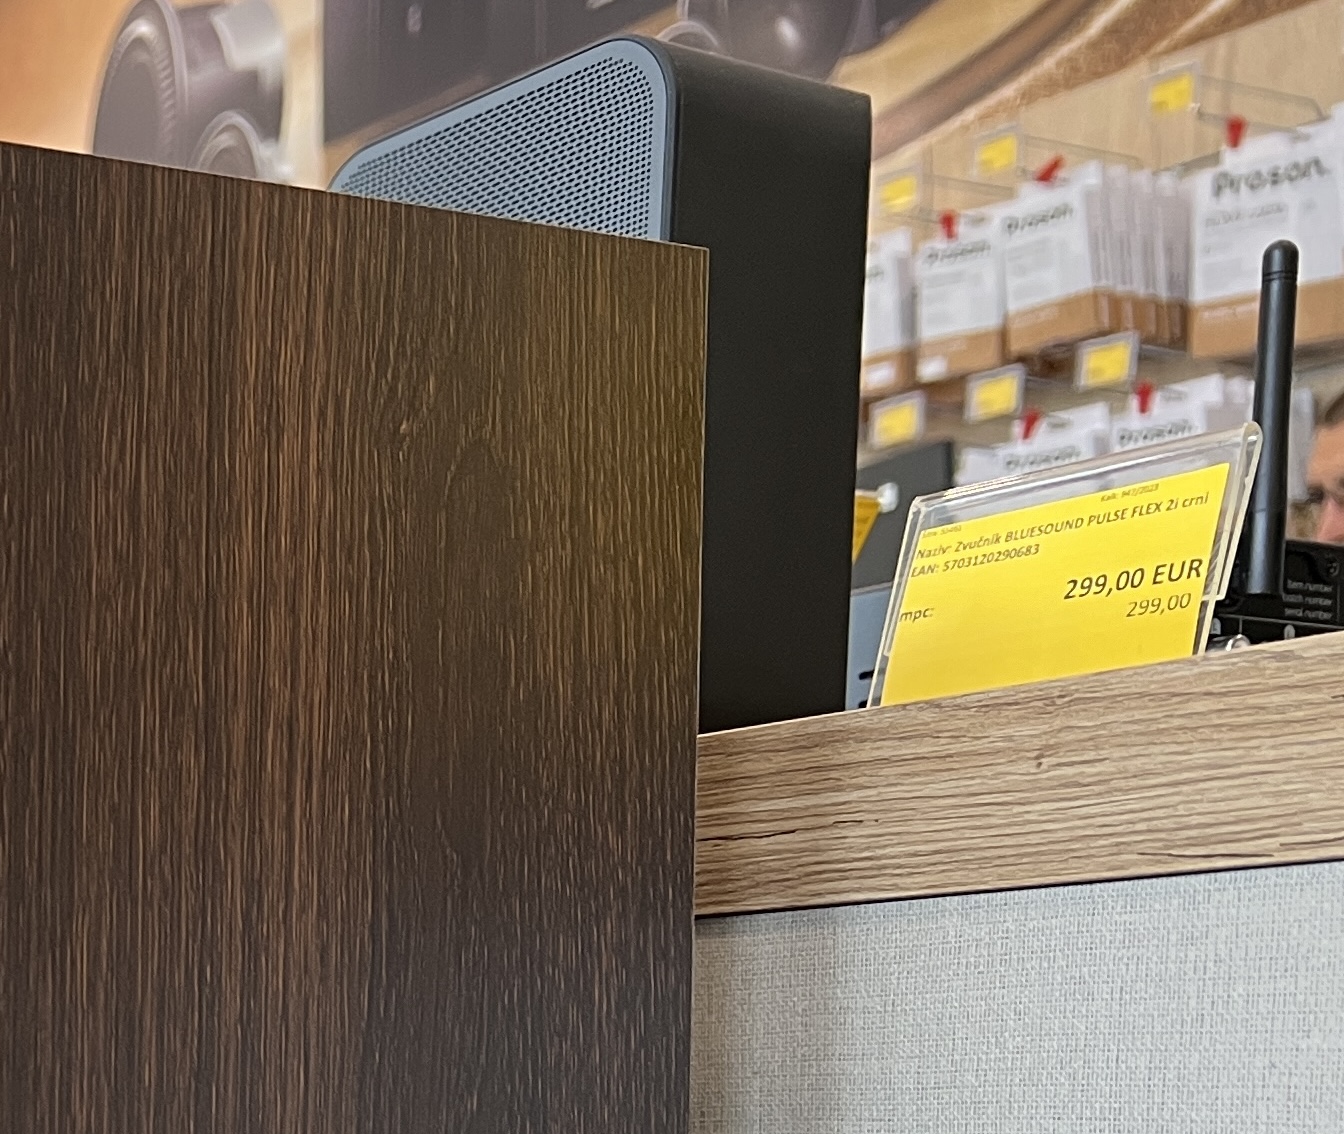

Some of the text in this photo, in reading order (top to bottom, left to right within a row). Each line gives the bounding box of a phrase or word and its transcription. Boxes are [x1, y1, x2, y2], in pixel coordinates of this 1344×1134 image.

[954, 533, 1002, 552] Zvučnik
[1004, 518, 1084, 543] BLUESOUND
[1087, 508, 1129, 527] PULSE
[1131, 501, 1163, 519] FLEX
[1166, 498, 1179, 512] 2i
[1182, 491, 1210, 508] crni
[911, 543, 1040, 577] EAN: 5703120290683
[1063, 558, 1204, 600] 299,00 EUR
[899, 607, 934, 623] mpc:
[1125, 592, 1192, 618] 299,00
